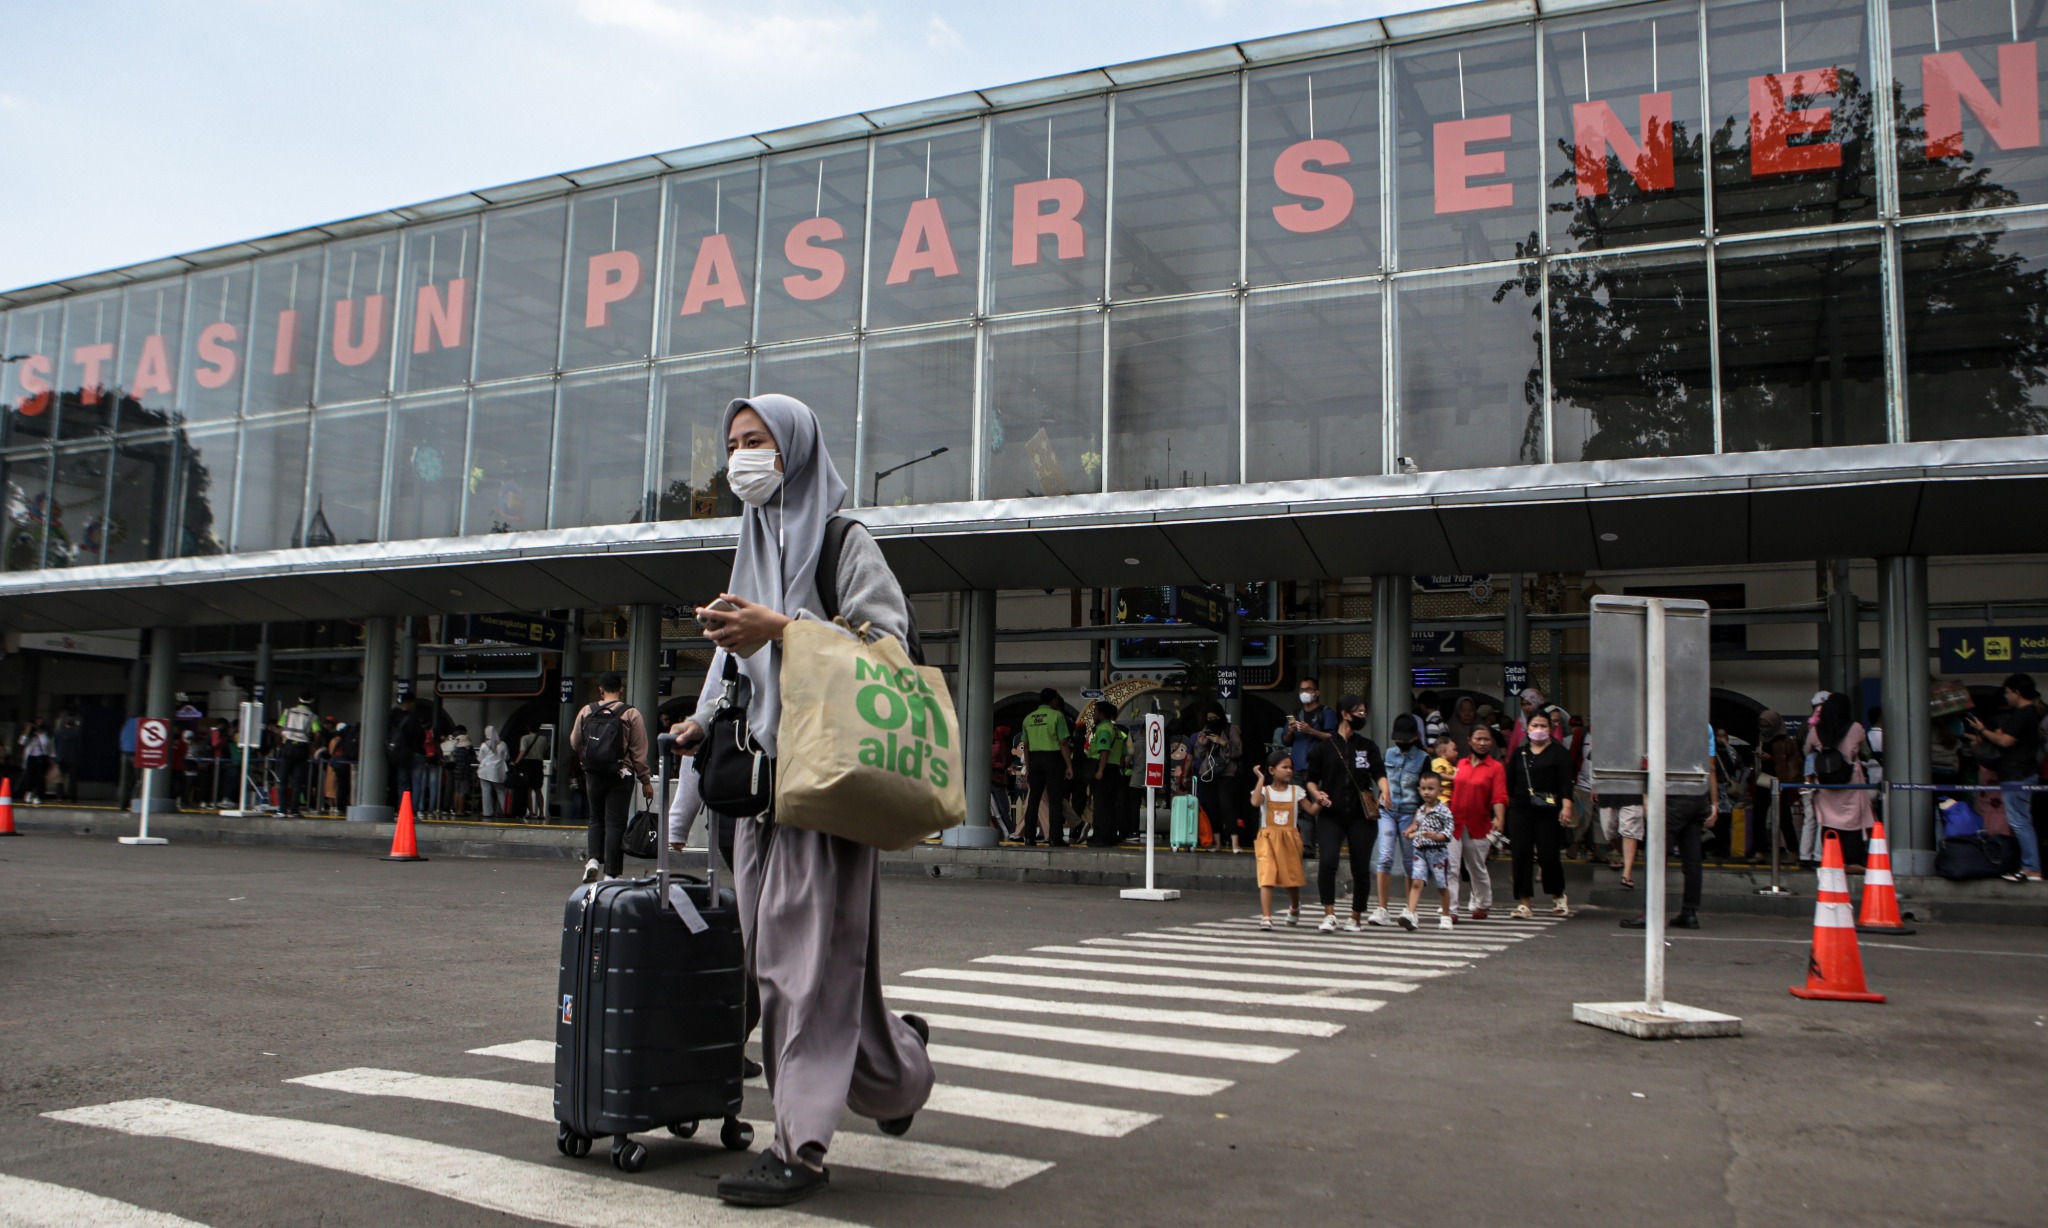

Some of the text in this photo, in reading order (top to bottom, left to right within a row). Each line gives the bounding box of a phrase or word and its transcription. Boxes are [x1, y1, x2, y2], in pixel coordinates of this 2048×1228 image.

[17, 41, 2040, 416] STASIUN PASAR SENEN
[1439, 631, 1456, 652] 2
[1217, 670, 1237, 678] Cetak
[1505, 666, 1527, 674] Cetak
[1217, 678, 1236, 686] Tiket
[1505, 674, 1526, 682] Tiket
[856, 684, 949, 749] on
[858, 732, 949, 788] ald's
